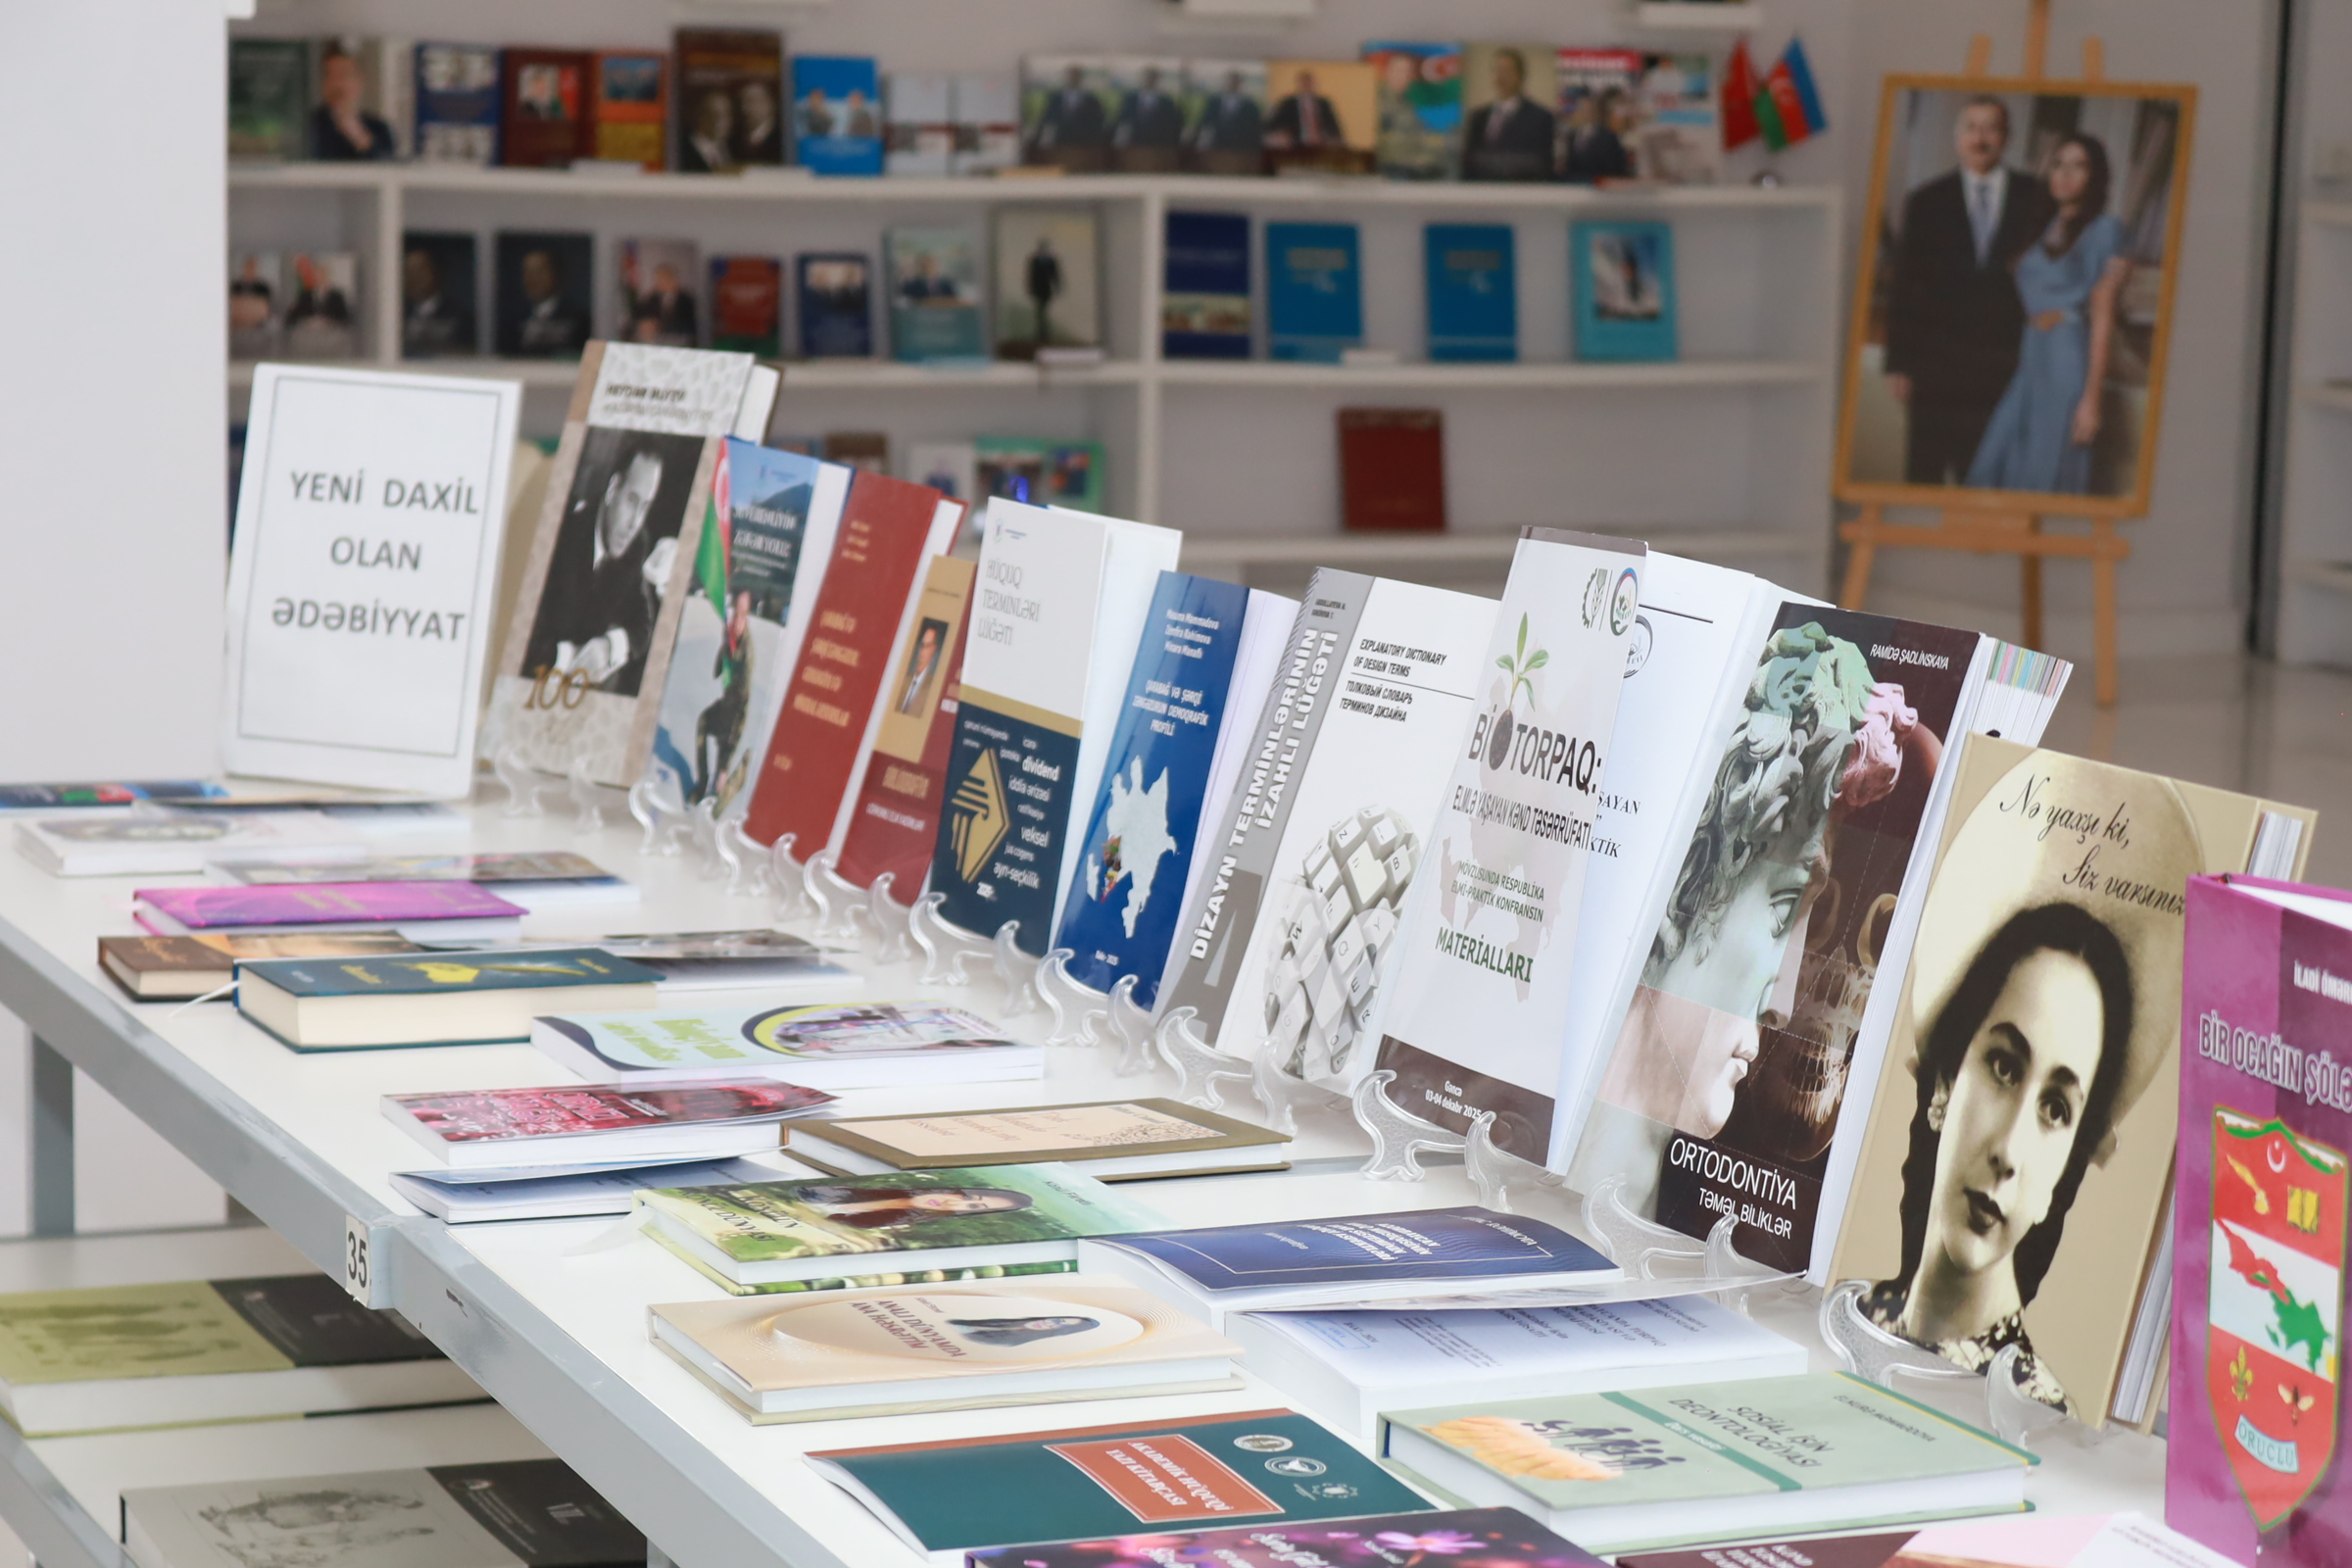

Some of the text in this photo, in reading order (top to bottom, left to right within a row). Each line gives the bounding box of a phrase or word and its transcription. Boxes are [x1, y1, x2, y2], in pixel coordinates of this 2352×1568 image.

[290, 468, 479, 514] YENİ DAXİL
[330, 536, 422, 571] OLAN
[986, 558, 1022, 590] HÜQUQ
[271, 597, 466, 641] ƏDƏBİYYAT
[1353, 656, 1411, 677] OF DESIGN TERMS
[1359, 639, 1447, 666] EXPLANATORY DICTIONARY
[1869, 643, 1900, 662] RAMİDƏ
[522, 664, 591, 710] 100
[1345, 680, 1413, 705] ТОЛКОВЫЙ СЛОВАРЬ
[1253, 736, 1301, 829] İZAHLI
[1292, 630, 1340, 731] LÜĞƏTİ
[1339, 698, 1407, 722] ТЕРМИНОВ ДИЗАЙНА
[1022, 756, 1059, 781] dividend
[1190, 627, 1318, 960] DİZAYN TERMİNLƏRİNİN
[1021, 826, 1049, 848] veksel
[1476, 792, 1508, 825] YAŞAYAN
[1507, 801, 1532, 831] KƏND
[1529, 808, 1592, 850] TƏSƏRRÜFATI
[1451, 879, 1544, 922] ELMİ-PRAKTİK KONFRANSIN
[1459, 859, 1544, 901] MÖVZUSUNDA RESPUBLİKA
[1435, 926, 1534, 983] MATERİALLARI
[2199, 1009, 2230, 1065] BİR
[2232, 1026, 2303, 1094] OCAĞIN
[1425, 1089, 1482, 1119] 03-04 dekabr 2025
[1670, 1138, 1796, 1210] ORTODONTİYA
[714, 1211, 776, 1242] DÜNYASI
[1698, 1187, 1792, 1240] TƏMƏL BİLİKLƏR
[348, 1231, 367, 1289] 35
[1668, 1398, 1822, 1467] DEONTOLOGİYASI
[1727, 1406, 1794, 1436] SOSİAL
[2238, 1422, 2293, 1467] ORUCLU
[1104, 1448, 1188, 1507] YAZI KİTABÇASI
[1127, 1441, 1235, 1512] AKADEMİK HÜQUQİ
